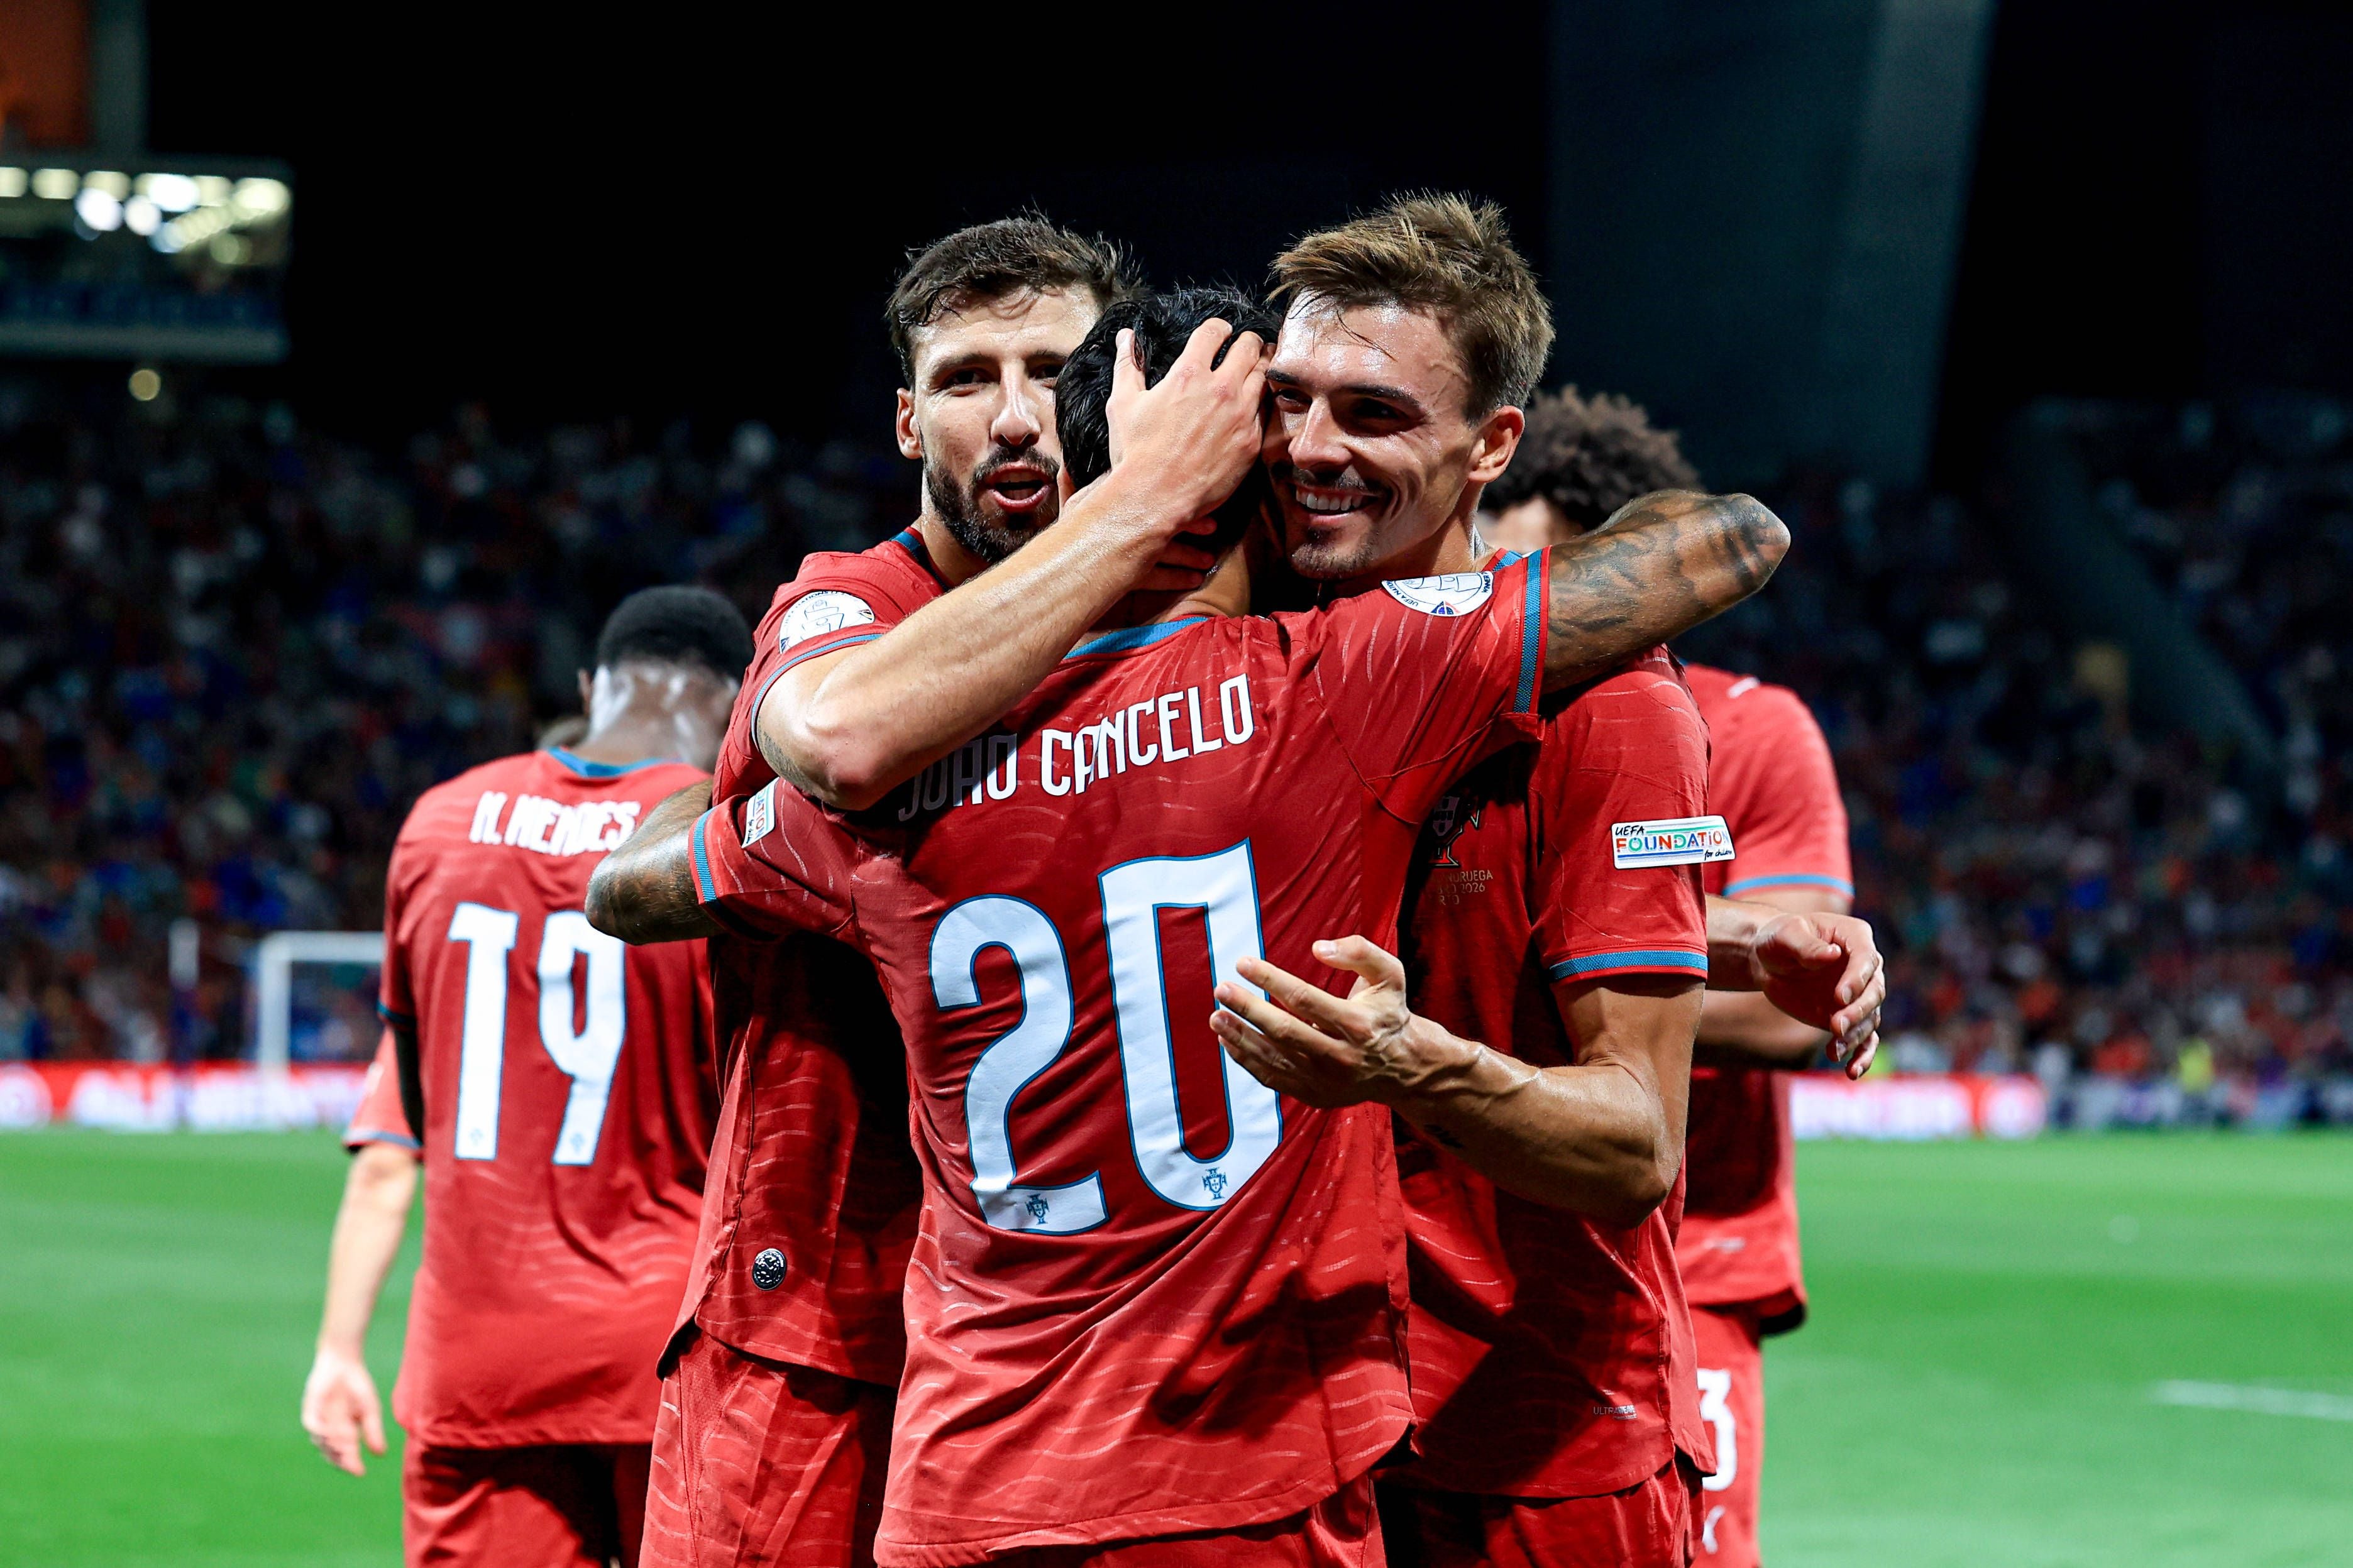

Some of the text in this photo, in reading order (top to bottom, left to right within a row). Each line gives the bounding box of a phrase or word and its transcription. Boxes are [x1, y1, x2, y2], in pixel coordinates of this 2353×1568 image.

[1386, 580, 1401, 596] NATIO
[1041, 673, 1255, 796] CANCELO
[504, 794, 642, 857] MENDES
[1615, 825, 1645, 836] UEFA
[1616, 830, 1731, 853] FOUNDATION
[1704, 849, 1714, 861] for
[447, 902, 626, 1165] 19
[929, 837, 1282, 1236] 20
